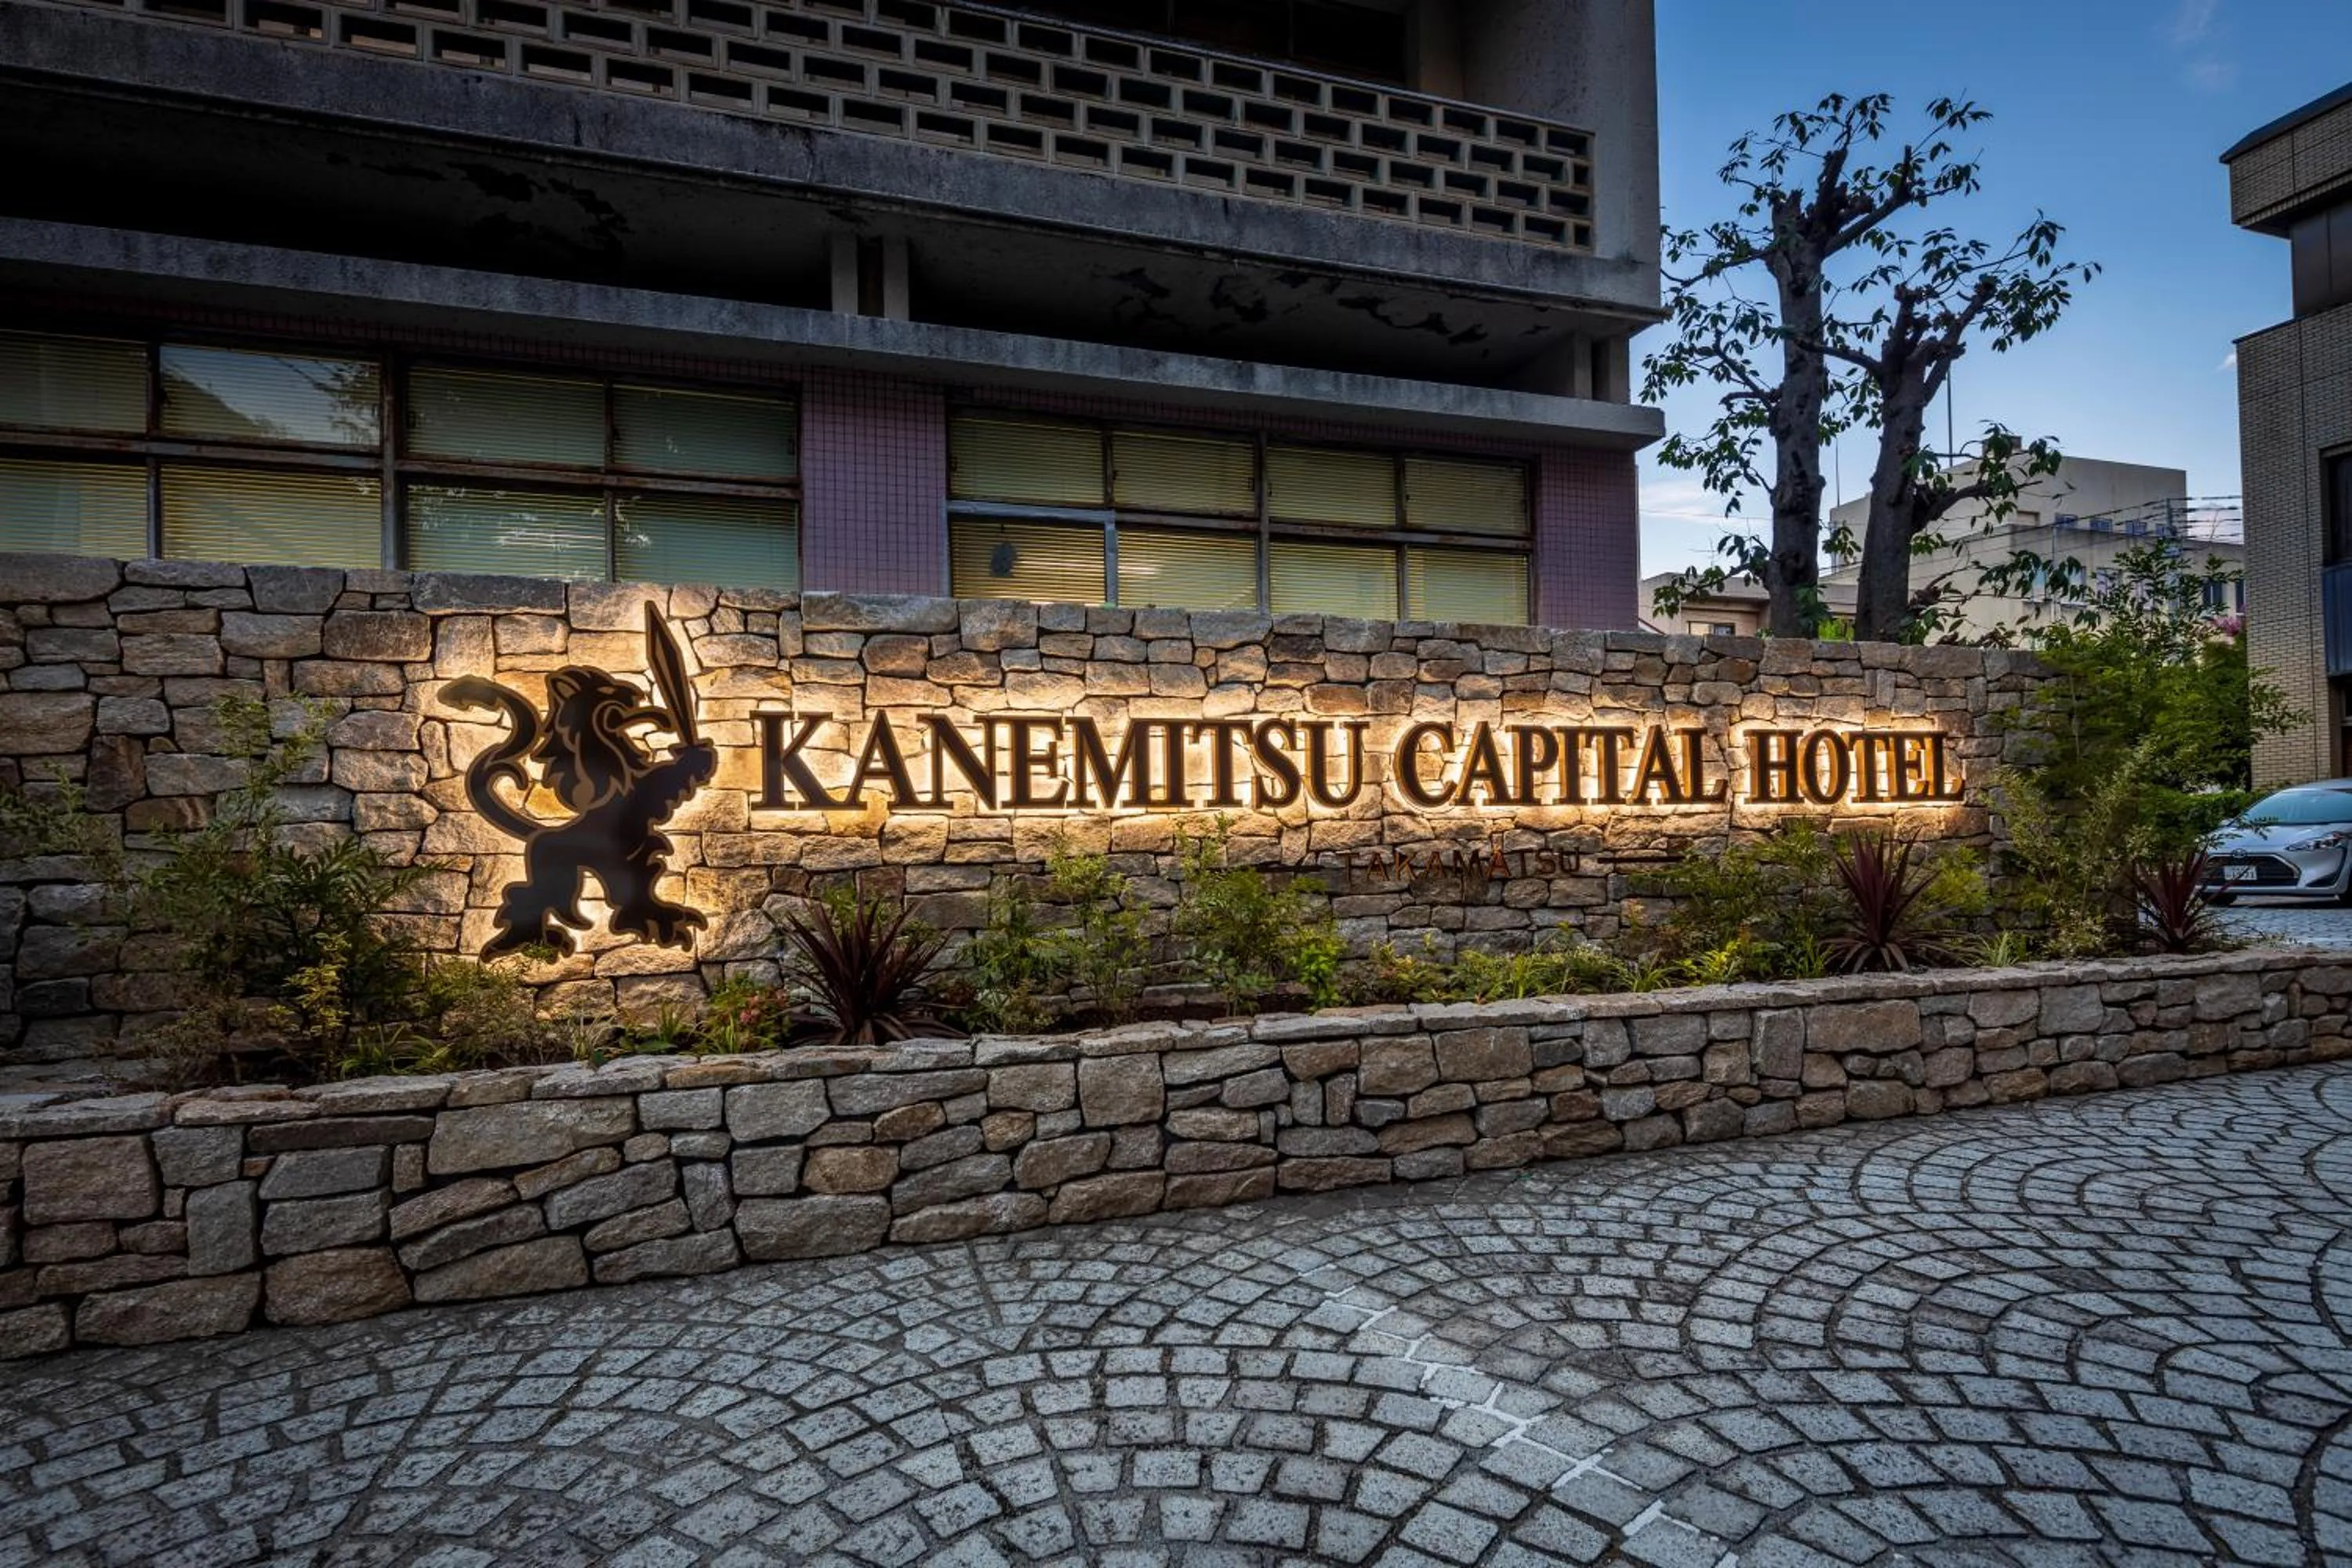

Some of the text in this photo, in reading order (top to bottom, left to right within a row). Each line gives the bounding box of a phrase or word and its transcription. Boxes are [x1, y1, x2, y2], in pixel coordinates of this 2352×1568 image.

[750, 710, 1965, 810] KANEMITSU CAPITAL HOTEL
[1336, 847, 1580, 881] TAKAMATSU
